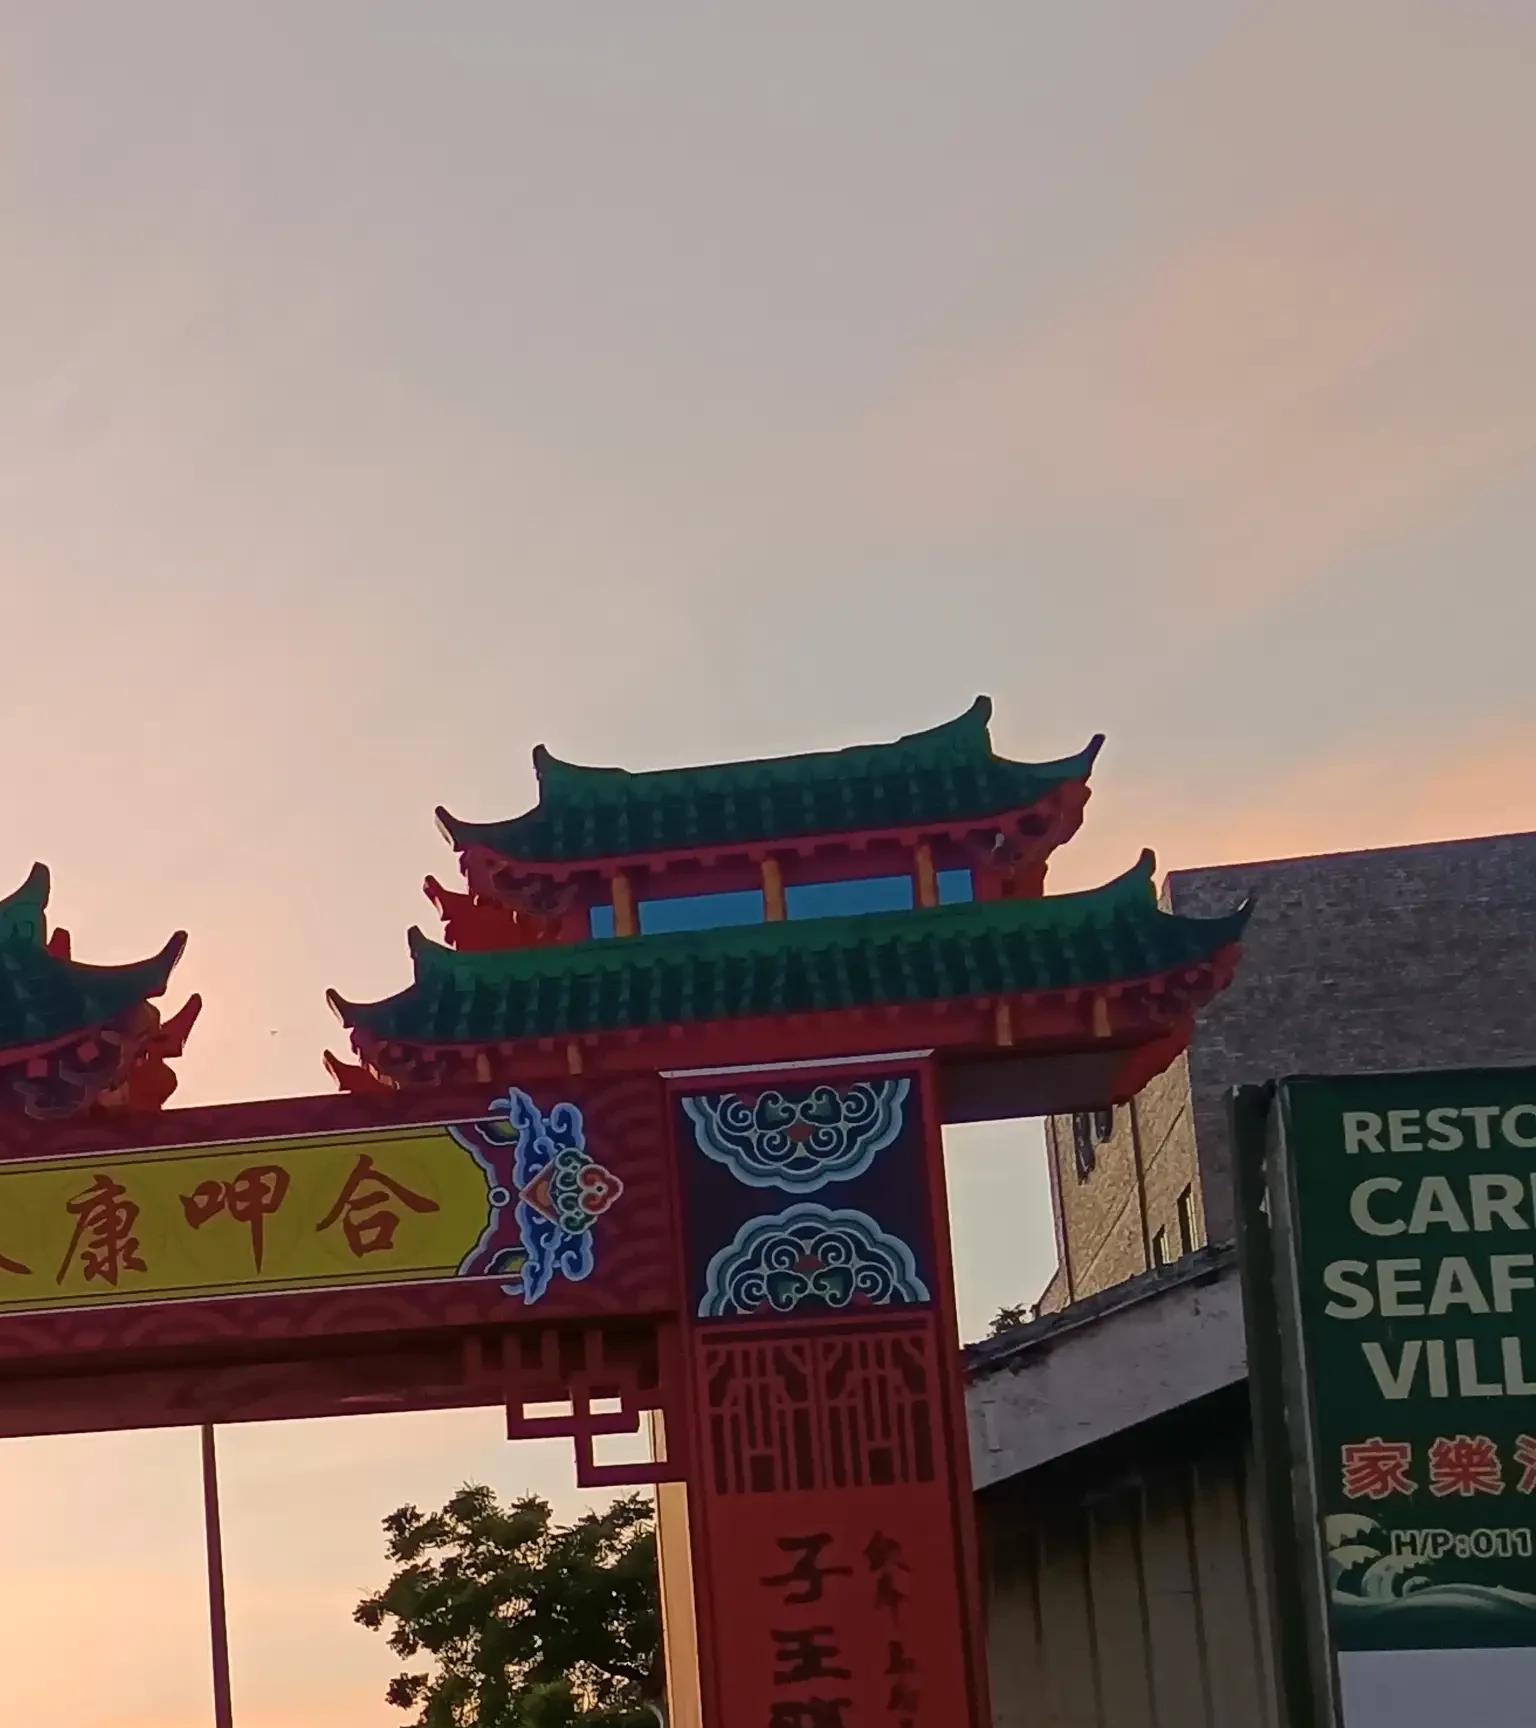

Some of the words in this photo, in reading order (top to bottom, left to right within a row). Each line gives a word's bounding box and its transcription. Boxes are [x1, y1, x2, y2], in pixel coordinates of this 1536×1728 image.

[1349, 1172, 1536, 1236] CAR
[1323, 1254, 1535, 1319] SEAF
[1361, 1337, 1536, 1399] VILL
